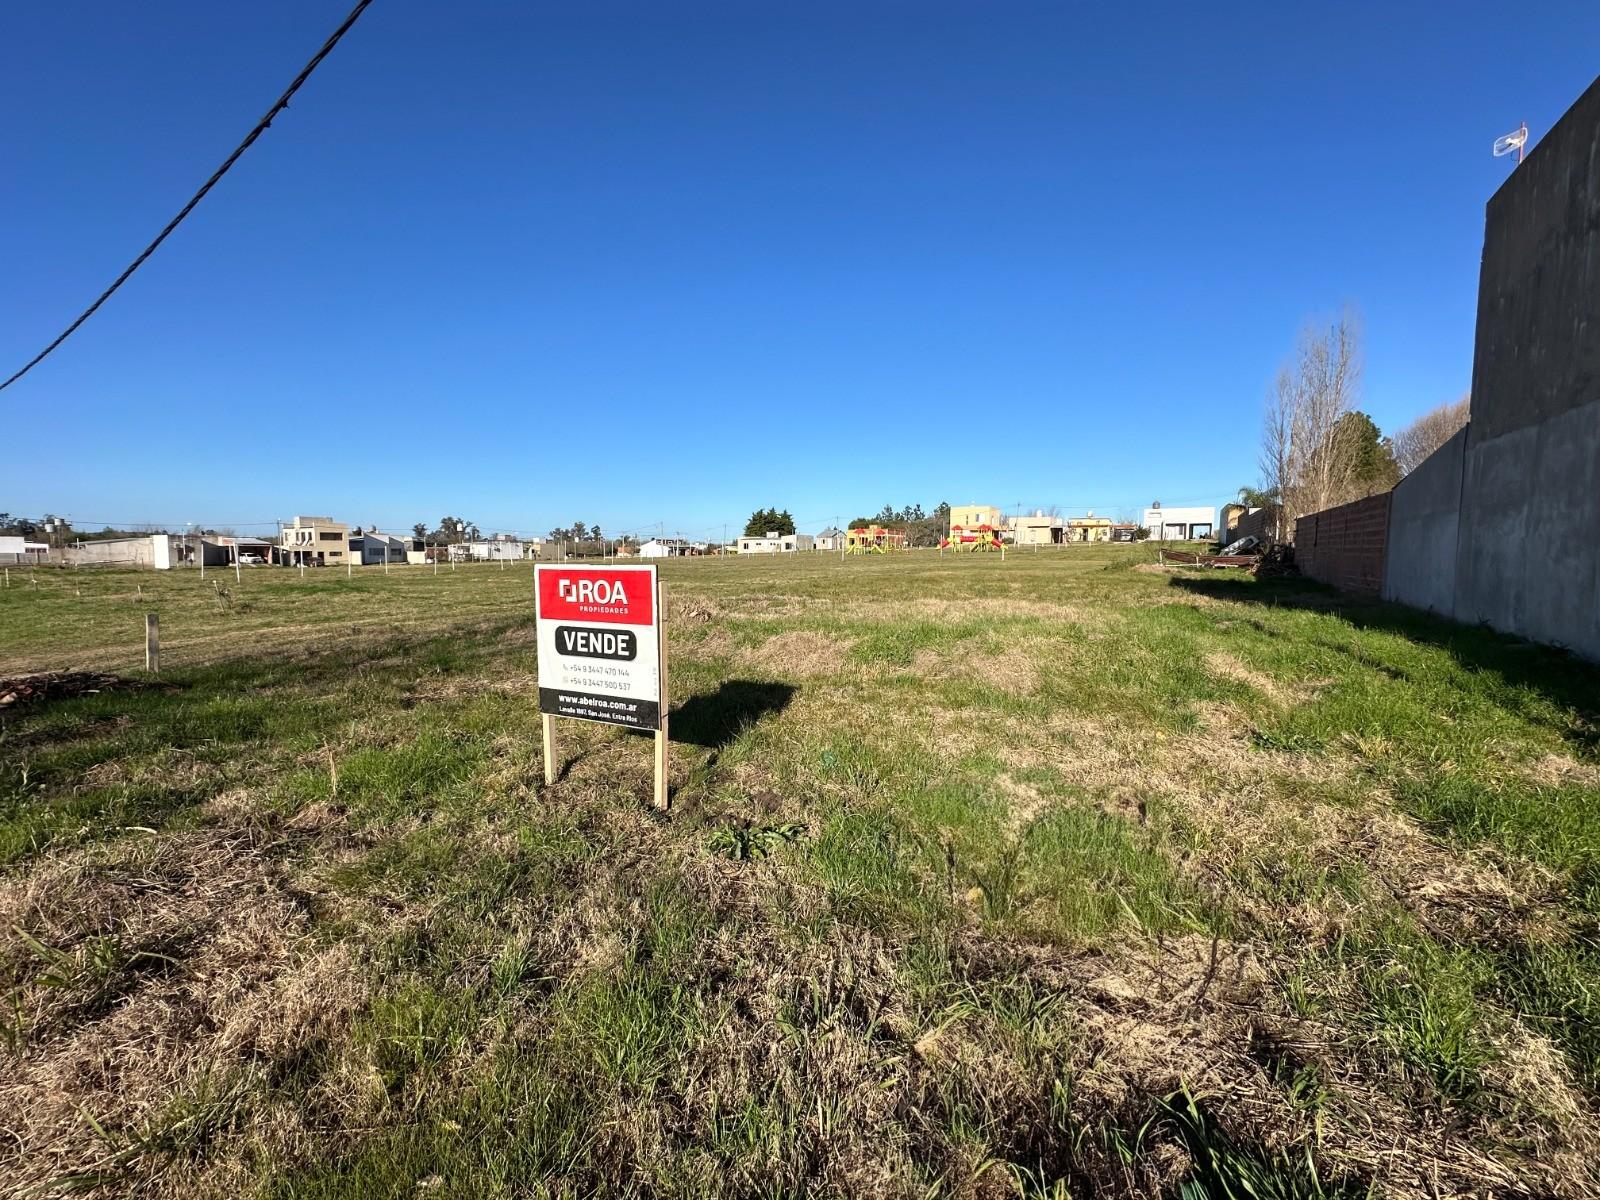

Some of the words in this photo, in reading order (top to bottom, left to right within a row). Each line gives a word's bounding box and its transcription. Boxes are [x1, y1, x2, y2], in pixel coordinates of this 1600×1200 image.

[579, 579, 629, 605] ROA
[579, 605, 629, 614] PROPIEDADES
[563, 630, 630, 656] VENDE
[570, 664, 581, 672] +54
[588, 665, 603, 674] 3447
[604, 667, 616, 676] 470
[570, 677, 581, 685] +54
[588, 679, 603, 687] 3447
[604, 681, 617, 689] 500
[618, 682, 631, 690] 537
[558, 694, 638, 712] www.abelroa.com.ar
[588, 709, 597, 717] San
